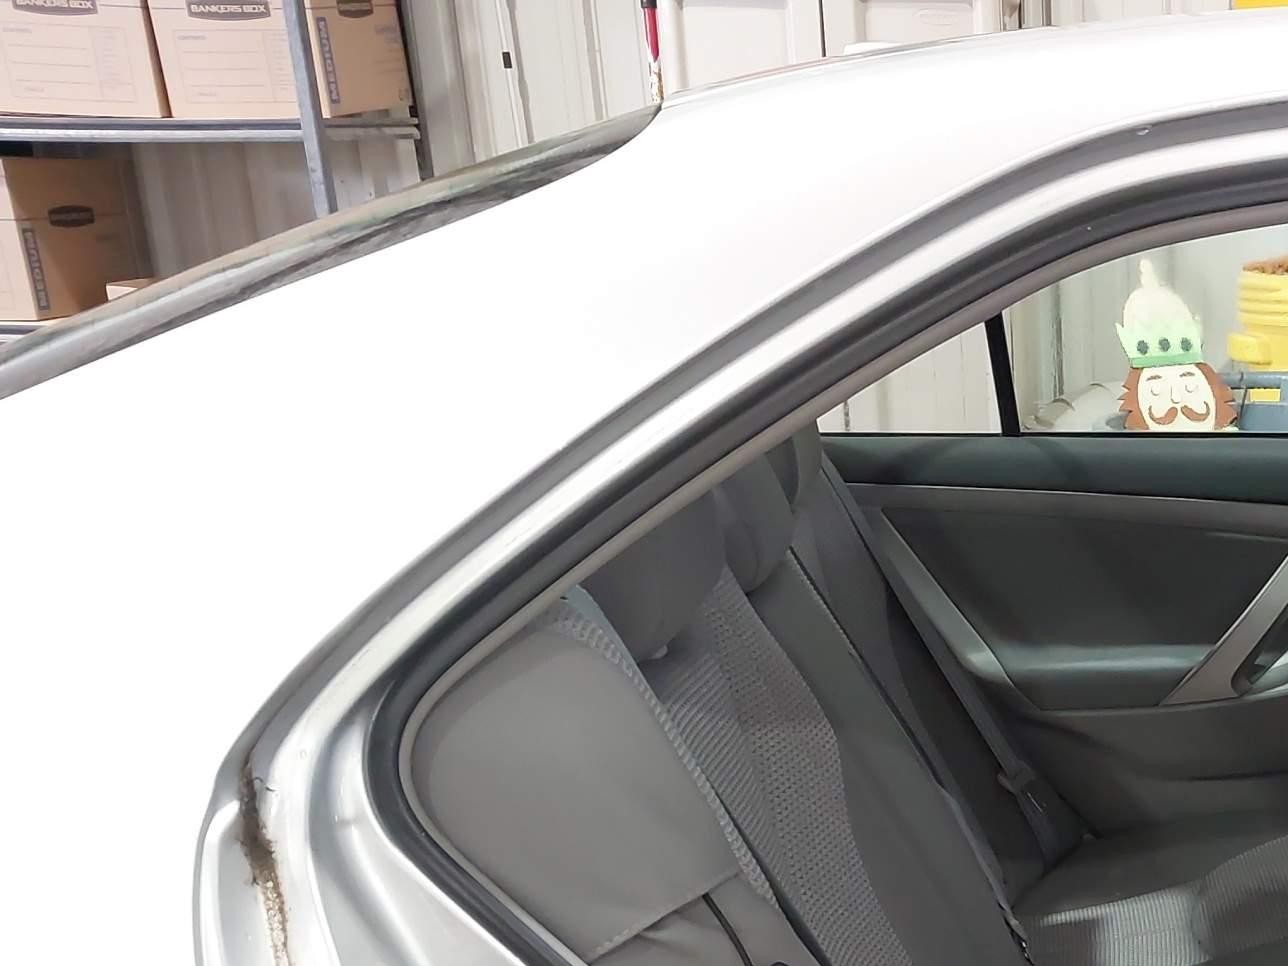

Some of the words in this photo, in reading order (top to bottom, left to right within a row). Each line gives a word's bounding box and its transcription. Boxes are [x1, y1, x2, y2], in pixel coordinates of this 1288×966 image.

[190, 4, 241, 13] BANKERS
[243, 4, 266, 13] BOX
[318, 20, 339, 101] MEDIUM
[23, 230, 48, 307] MEDIUM
